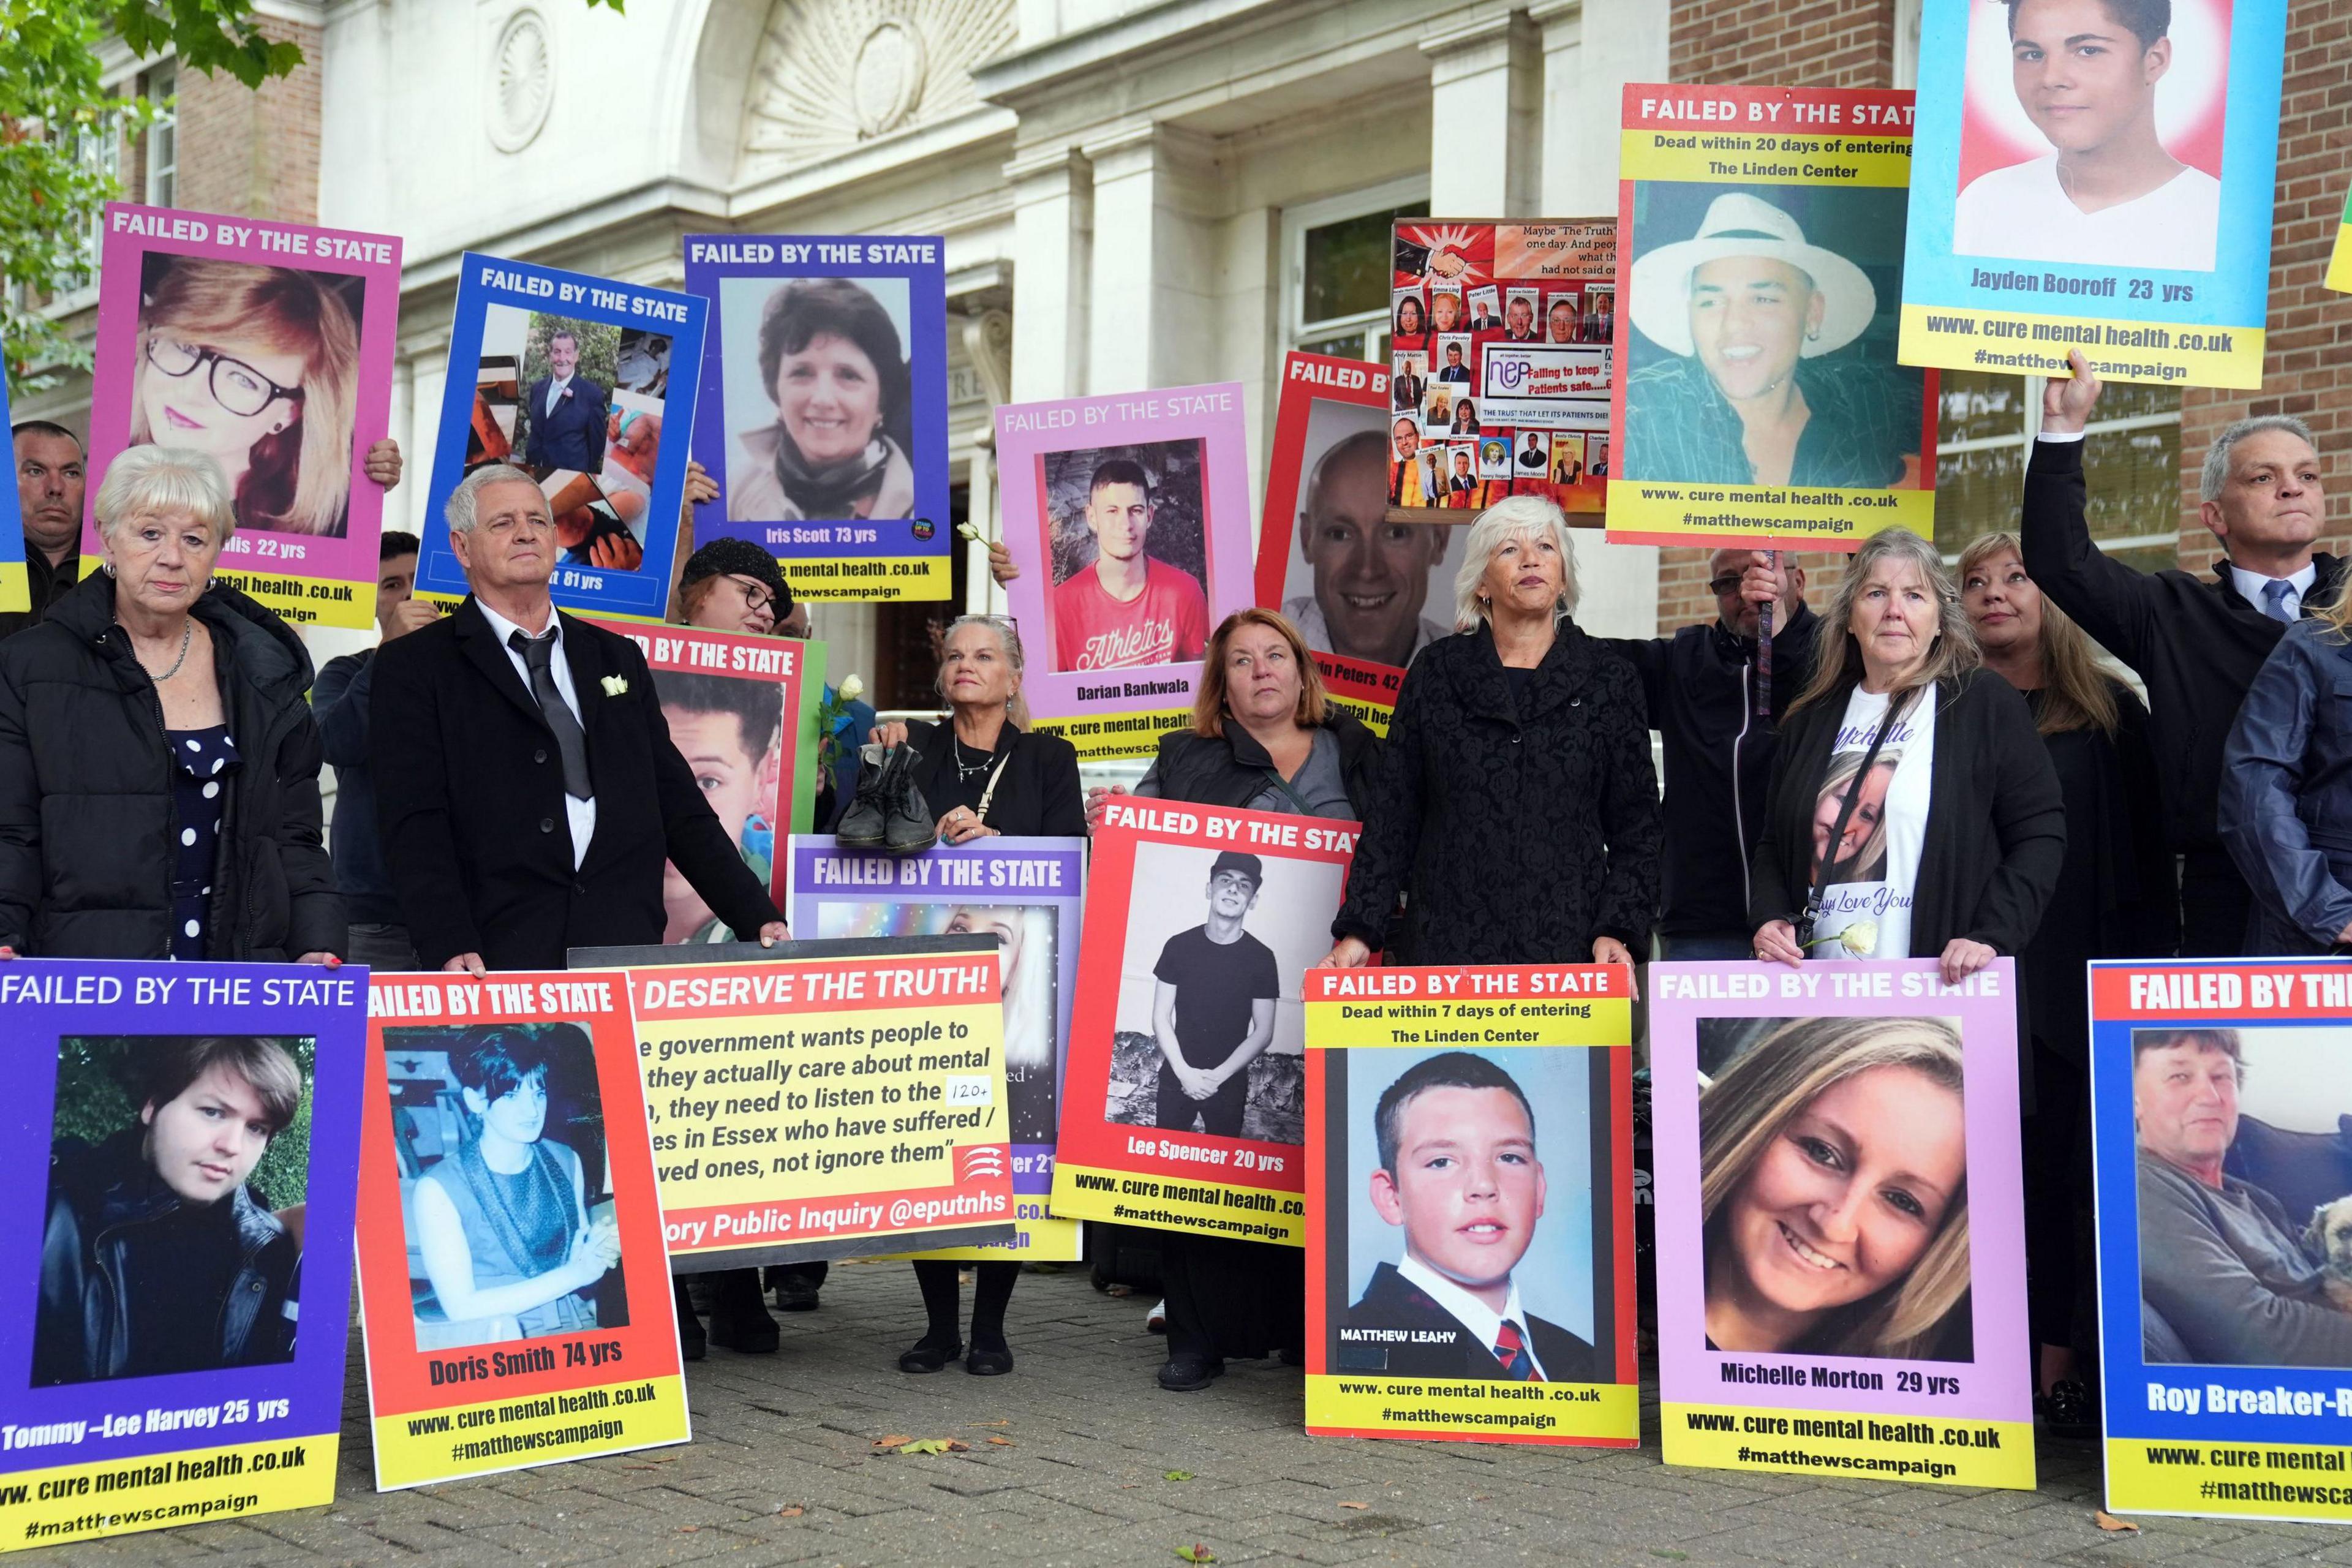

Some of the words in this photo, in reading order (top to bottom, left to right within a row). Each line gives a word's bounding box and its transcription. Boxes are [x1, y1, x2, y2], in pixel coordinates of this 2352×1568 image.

[1642, 99, 1737, 122] FAILED
[1748, 101, 1783, 123] BY
[1793, 104, 1841, 124] THE
[1654, 135, 1697, 150] Dead
[1702, 136, 1752, 152] within
[1756, 138, 1777, 152] 20
[1781, 138, 1820, 156] days
[1824, 139, 1842, 154] of
[1844, 141, 1913, 156] entering
[1708, 161, 1738, 176] The
[1743, 162, 1798, 177] Linden
[1803, 164, 1858, 179] Center
[113, 212, 209, 242] FAILED
[217, 224, 254, 247] BY
[258, 229, 309, 255] THE
[315, 238, 392, 264] STATE
[1523, 227, 1556, 237] Maybe
[1548, 239, 1567, 250] day.
[1570, 239, 1591, 248] And
[692, 244, 775, 263] FAILED
[780, 244, 812, 263] BY
[815, 244, 864, 263] THE
[867, 244, 935, 264] STATE
[1578, 253, 1603, 262] what
[1542, 265, 1560, 274] had
[1583, 265, 1603, 274] said
[481, 268, 554, 297] FAILED
[559, 284, 586, 303] BY
[591, 288, 627, 312] THE
[631, 297, 688, 323] STATE
[1971, 268, 2038, 293] Jayden
[2043, 273, 2116, 298] Booroff
[2128, 279, 2154, 300] 23
[2162, 282, 2193, 303] yrs
[1290, 361, 1366, 391] FAILED
[1564, 367, 1573, 377] to
[1575, 365, 1599, 376] keep
[1528, 383, 1568, 395] Patients
[1005, 407, 1076, 434] FAILED
[1084, 405, 1111, 425] BY
[1116, 399, 1159, 421] THE
[1167, 393, 1232, 415] STATE
[257, 539, 277, 556] 22
[281, 543, 306, 559] yrs
[766, 528, 791, 544] Iris
[793, 527, 830, 543] Scott
[835, 527, 853, 543] 73
[854, 529, 876, 544] yrs
[252, 577, 303, 597] health
[306, 585, 352, 601] .co.uk
[564, 571, 579, 587] 81
[581, 575, 603, 590] yrs
[654, 638, 684, 664] BY
[688, 641, 727, 669] THE
[732, 645, 793, 676] STATE
[1076, 618, 1174, 671] Athletics
[1077, 684, 1121, 701] Darian
[1124, 679, 1189, 697] Bankwala
[1335, 663, 1378, 686] Peters
[1382, 674, 1400, 690] 42
[814, 858, 894, 884] FAILED
[900, 859, 934, 886] BY
[937, 859, 983, 886] THE
[990, 859, 1061, 888] STATE
[1837, 890, 1872, 912] Love
[1873, 886, 1912, 916] You
[1, 975, 122, 1005] FAILED
[135, 977, 178, 1005] BY
[186, 978, 251, 1005] THE
[262, 979, 355, 1006] STATE
[644, 973, 793, 1009] DESERVE
[802, 971, 865, 1001] THE
[873, 965, 988, 998] TRUTH!
[2130, 973, 2242, 1009] FAILED
[2250, 974, 2294, 1008] BY
[1342, 1006, 1382, 1018] Dead
[1387, 1006, 1437, 1018] within
[1442, 1005, 1451, 1017] 7
[1456, 1005, 1494, 1019] days
[1499, 1003, 1516, 1016] of
[1520, 1003, 1591, 1018] entering
[659, 1031, 796, 1061] government
[801, 1025, 865, 1049] wants
[871, 1022, 943, 1051] people
[948, 1021, 968, 1040] to
[1392, 1030, 1420, 1043] The
[1425, 1029, 1479, 1042] Linden
[1484, 1029, 1539, 1042] Center
[647, 1066, 698, 1091] they
[704, 1060, 791, 1088] actually
[798, 1058, 846, 1079] care
[852, 1052, 913, 1077] about
[918, 1047, 990, 1071] mental
[669, 1096, 718, 1123] they
[725, 1093, 782, 1115] need
[786, 1090, 808, 1109] to
[814, 1084, 874, 1108] listen
[881, 1084, 902, 1102] to
[908, 1082, 941, 1101] the
[684, 1127, 706, 1149] in
[710, 1123, 778, 1147] Essex
[784, 1119, 829, 1140] who
[835, 1115, 886, 1137] have
[891, 1109, 981, 1133] suffered
[705, 1157, 764, 1181] ones,
[772, 1152, 810, 1174] not
[815, 1147, 886, 1174] ignore
[1128, 1136, 1155, 1156] Lee
[1159, 1140, 1227, 1164] Spencer
[1234, 1150, 1254, 1168] 20
[1257, 1154, 1284, 1172] yrs
[713, 1209, 791, 1238] Public
[797, 1202, 884, 1234] Inquiry
[889, 1192, 1006, 1229] @eputnhs
[1341, 1329, 1408, 1343] MATTHEW
[1411, 1331, 1457, 1344] LEAHY
[429, 1356, 489, 1386] Doris
[492, 1346, 556, 1378] Smith
[562, 1341, 586, 1368] 74
[590, 1341, 623, 1368] yrs
[1721, 1362, 1806, 1386] Michelle
[1811, 1367, 1883, 1390] Morton
[1896, 1371, 1923, 1393] 29
[1926, 1376, 1960, 1395] yrs
[2147, 1383, 2201, 1415] Roy
[2, 1420, 87, 1450] Tommy
[145, 1404, 221, 1433] Harvey
[222, 1399, 249, 1423] 25
[257, 1398, 290, 1422] yrs
[1382, 1408, 1556, 1428] #matthewscampaign
